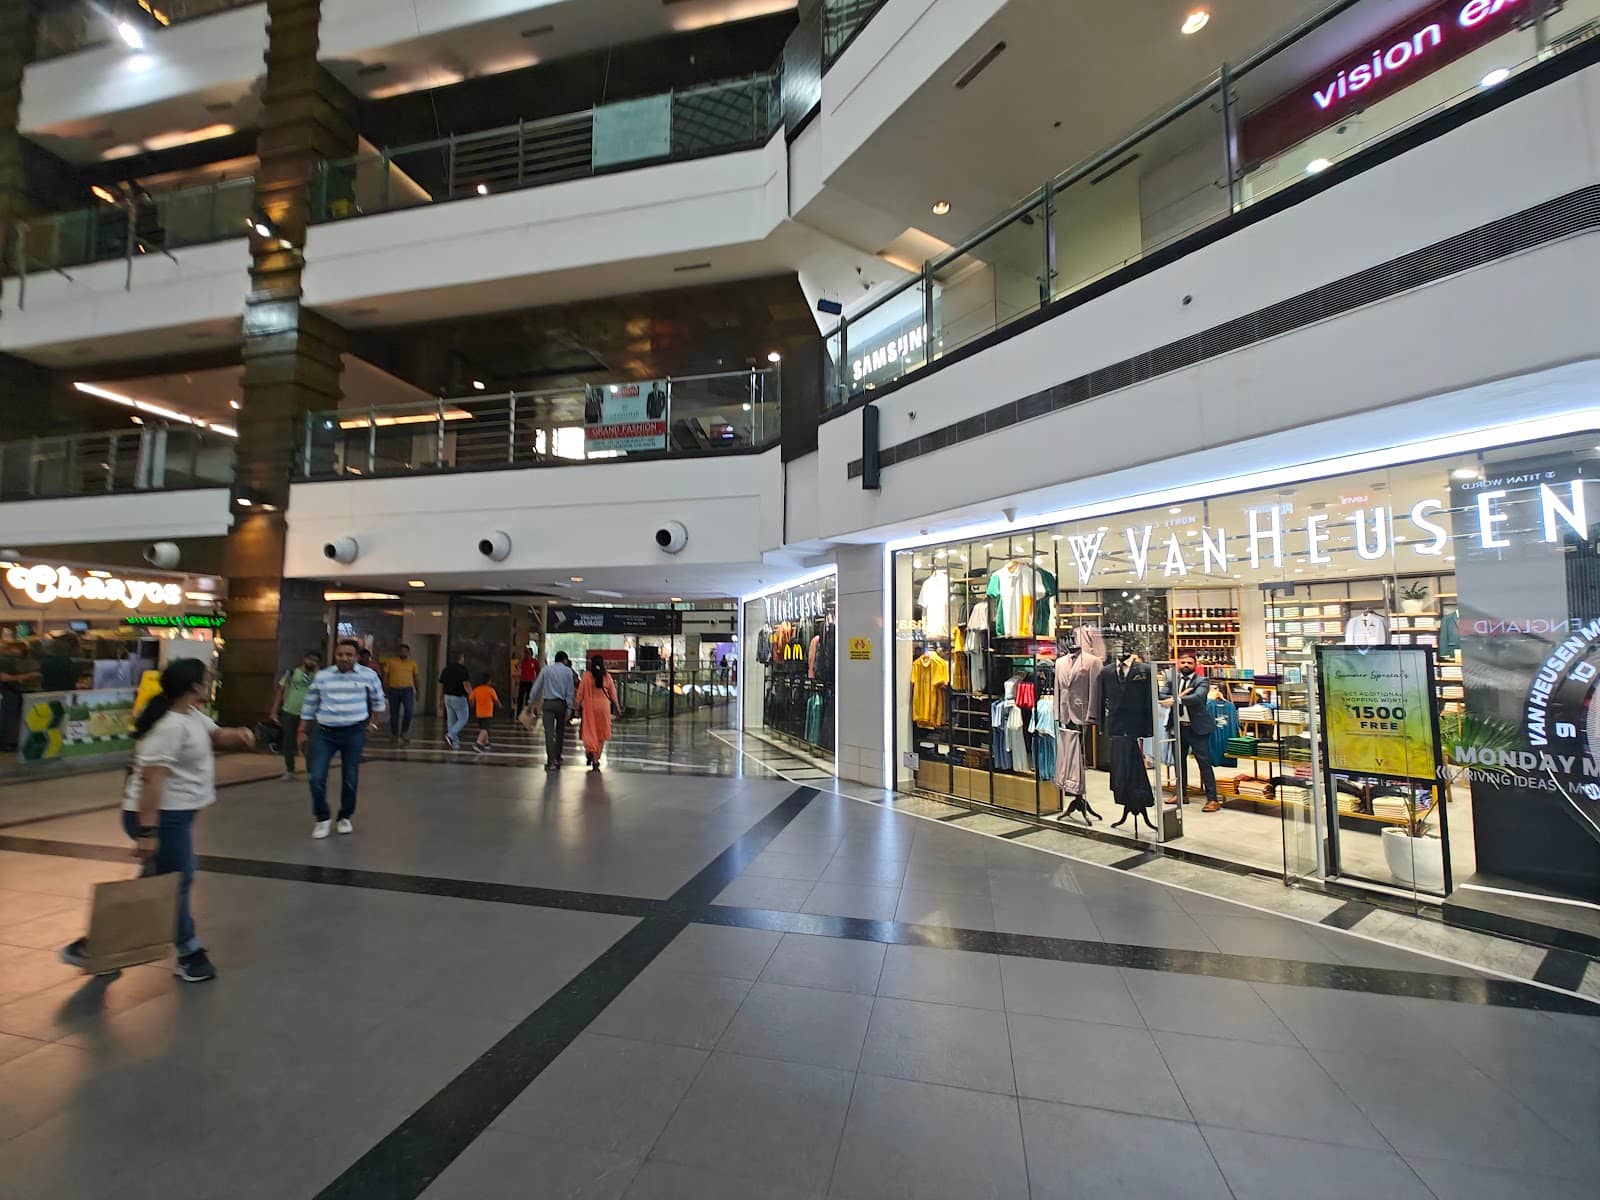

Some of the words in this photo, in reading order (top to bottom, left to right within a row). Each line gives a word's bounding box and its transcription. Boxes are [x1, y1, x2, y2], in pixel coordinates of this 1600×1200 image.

[1312, 22, 1442, 110] vision
[621, 422, 657, 434] FASHION
[6, 564, 182, 608] Chaayos
[1568, 661, 1597, 684] 10
[1360, 721, 1399, 731] FREE
[1555, 721, 1577, 738] 9
[1454, 746, 1576, 774] MONDAY
[1514, 773, 1558, 792] IDEAS
